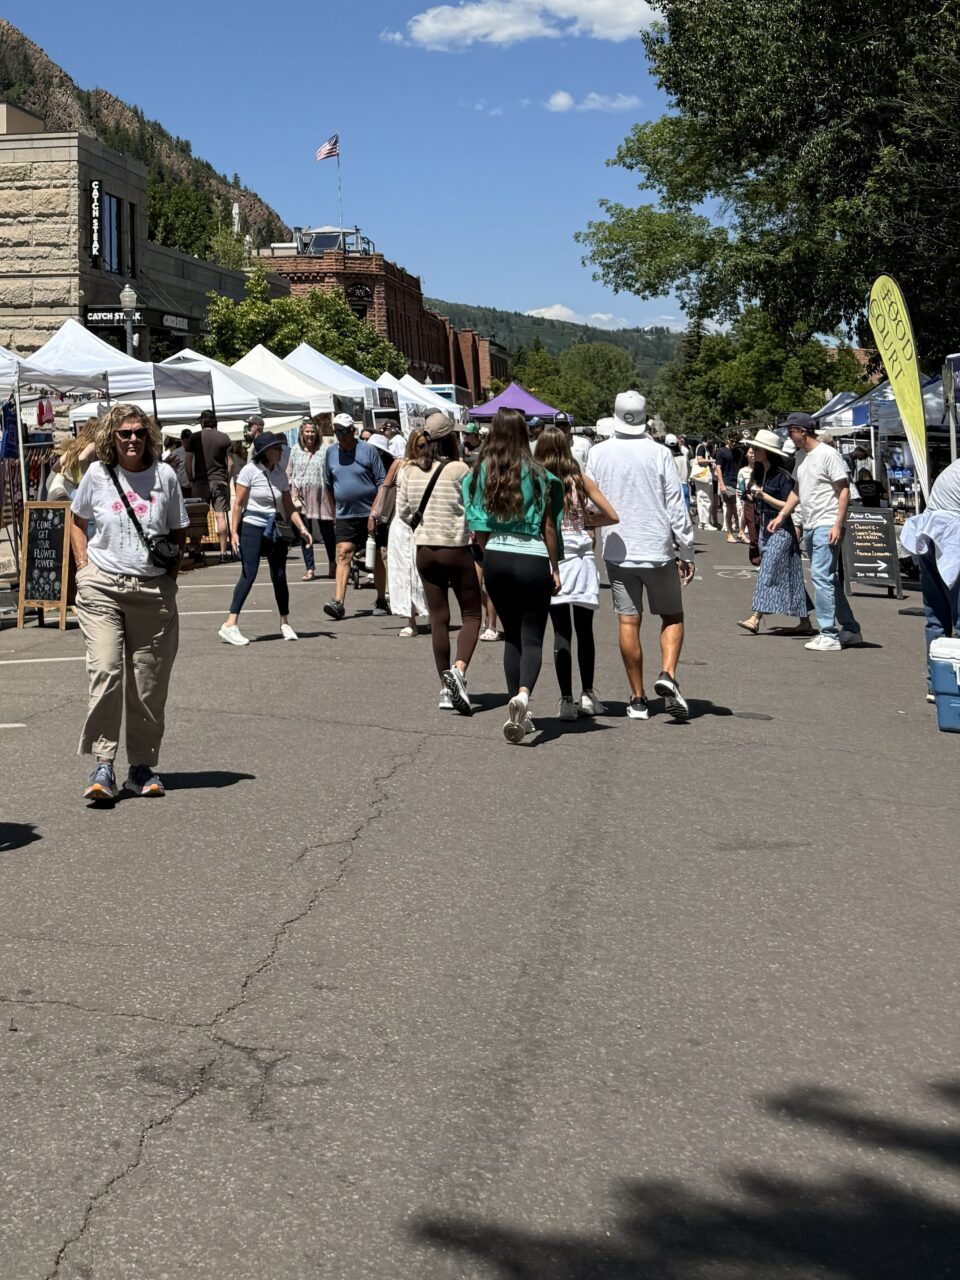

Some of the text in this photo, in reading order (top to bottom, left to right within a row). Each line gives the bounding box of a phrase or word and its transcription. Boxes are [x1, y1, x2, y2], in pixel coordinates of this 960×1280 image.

[91, 181, 100, 256] CATCH STEAK
[87, 312, 141, 320] CATCH STK
[882, 289, 914, 362] FOOD
[869, 298, 906, 380] COURT
[36, 520, 52, 529] COME
[38, 530, 49, 539] GET
[34, 549, 56, 559] FLOWER
